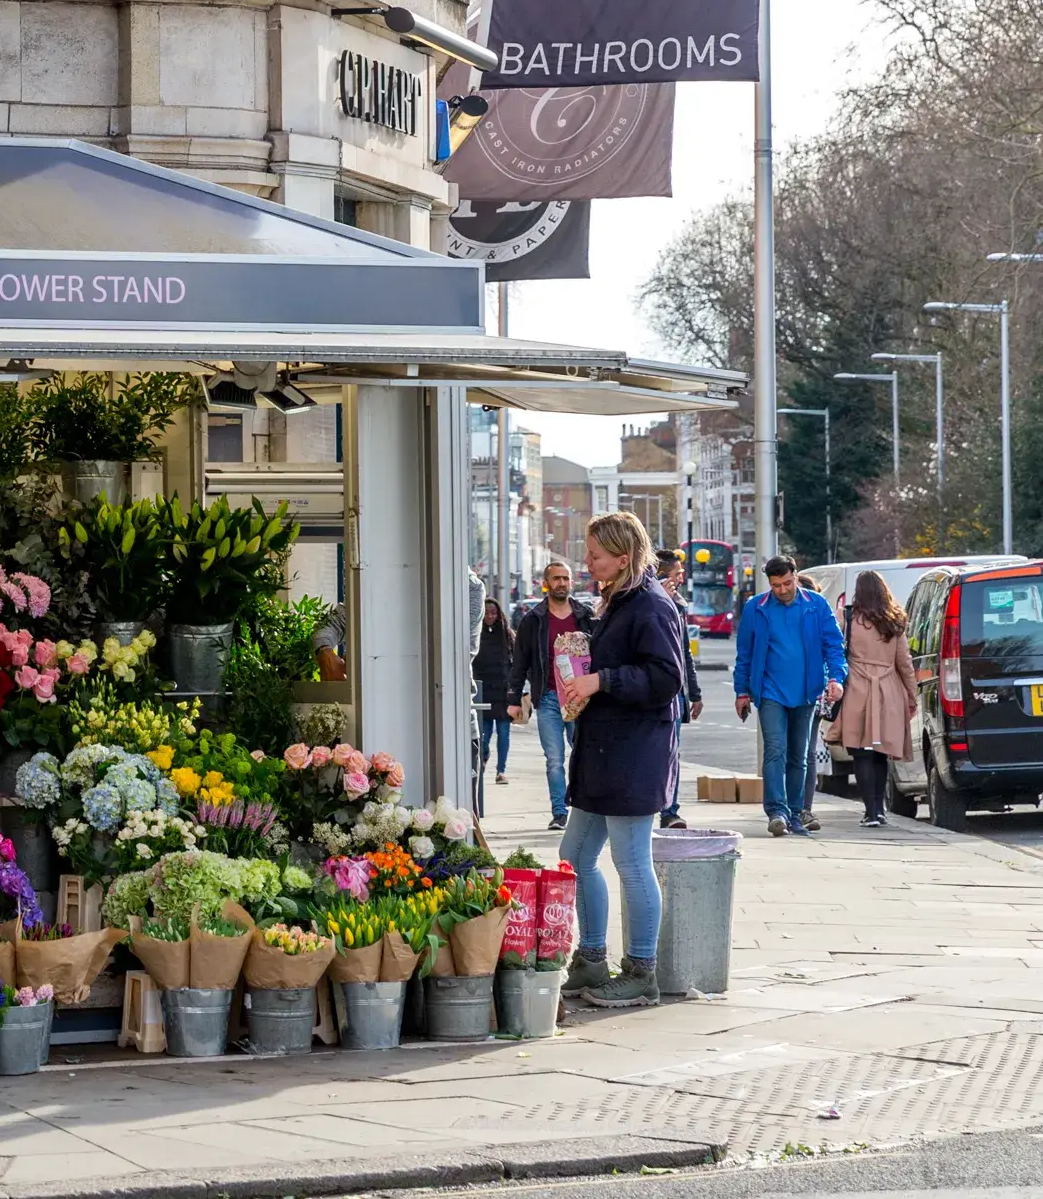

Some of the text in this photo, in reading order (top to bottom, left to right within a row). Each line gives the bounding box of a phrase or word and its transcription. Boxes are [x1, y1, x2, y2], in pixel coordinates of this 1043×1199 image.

[499, 32, 743, 76] BATHROOMS
[484, 117, 628, 174] CAST IRON RADIATORS
[447, 234, 475, 256] NT
[487, 250, 497, 260] &
[512, 201, 567, 255] PAPER
[92, 275, 186, 304] STAND
[505, 925, 534, 937] OYAL
